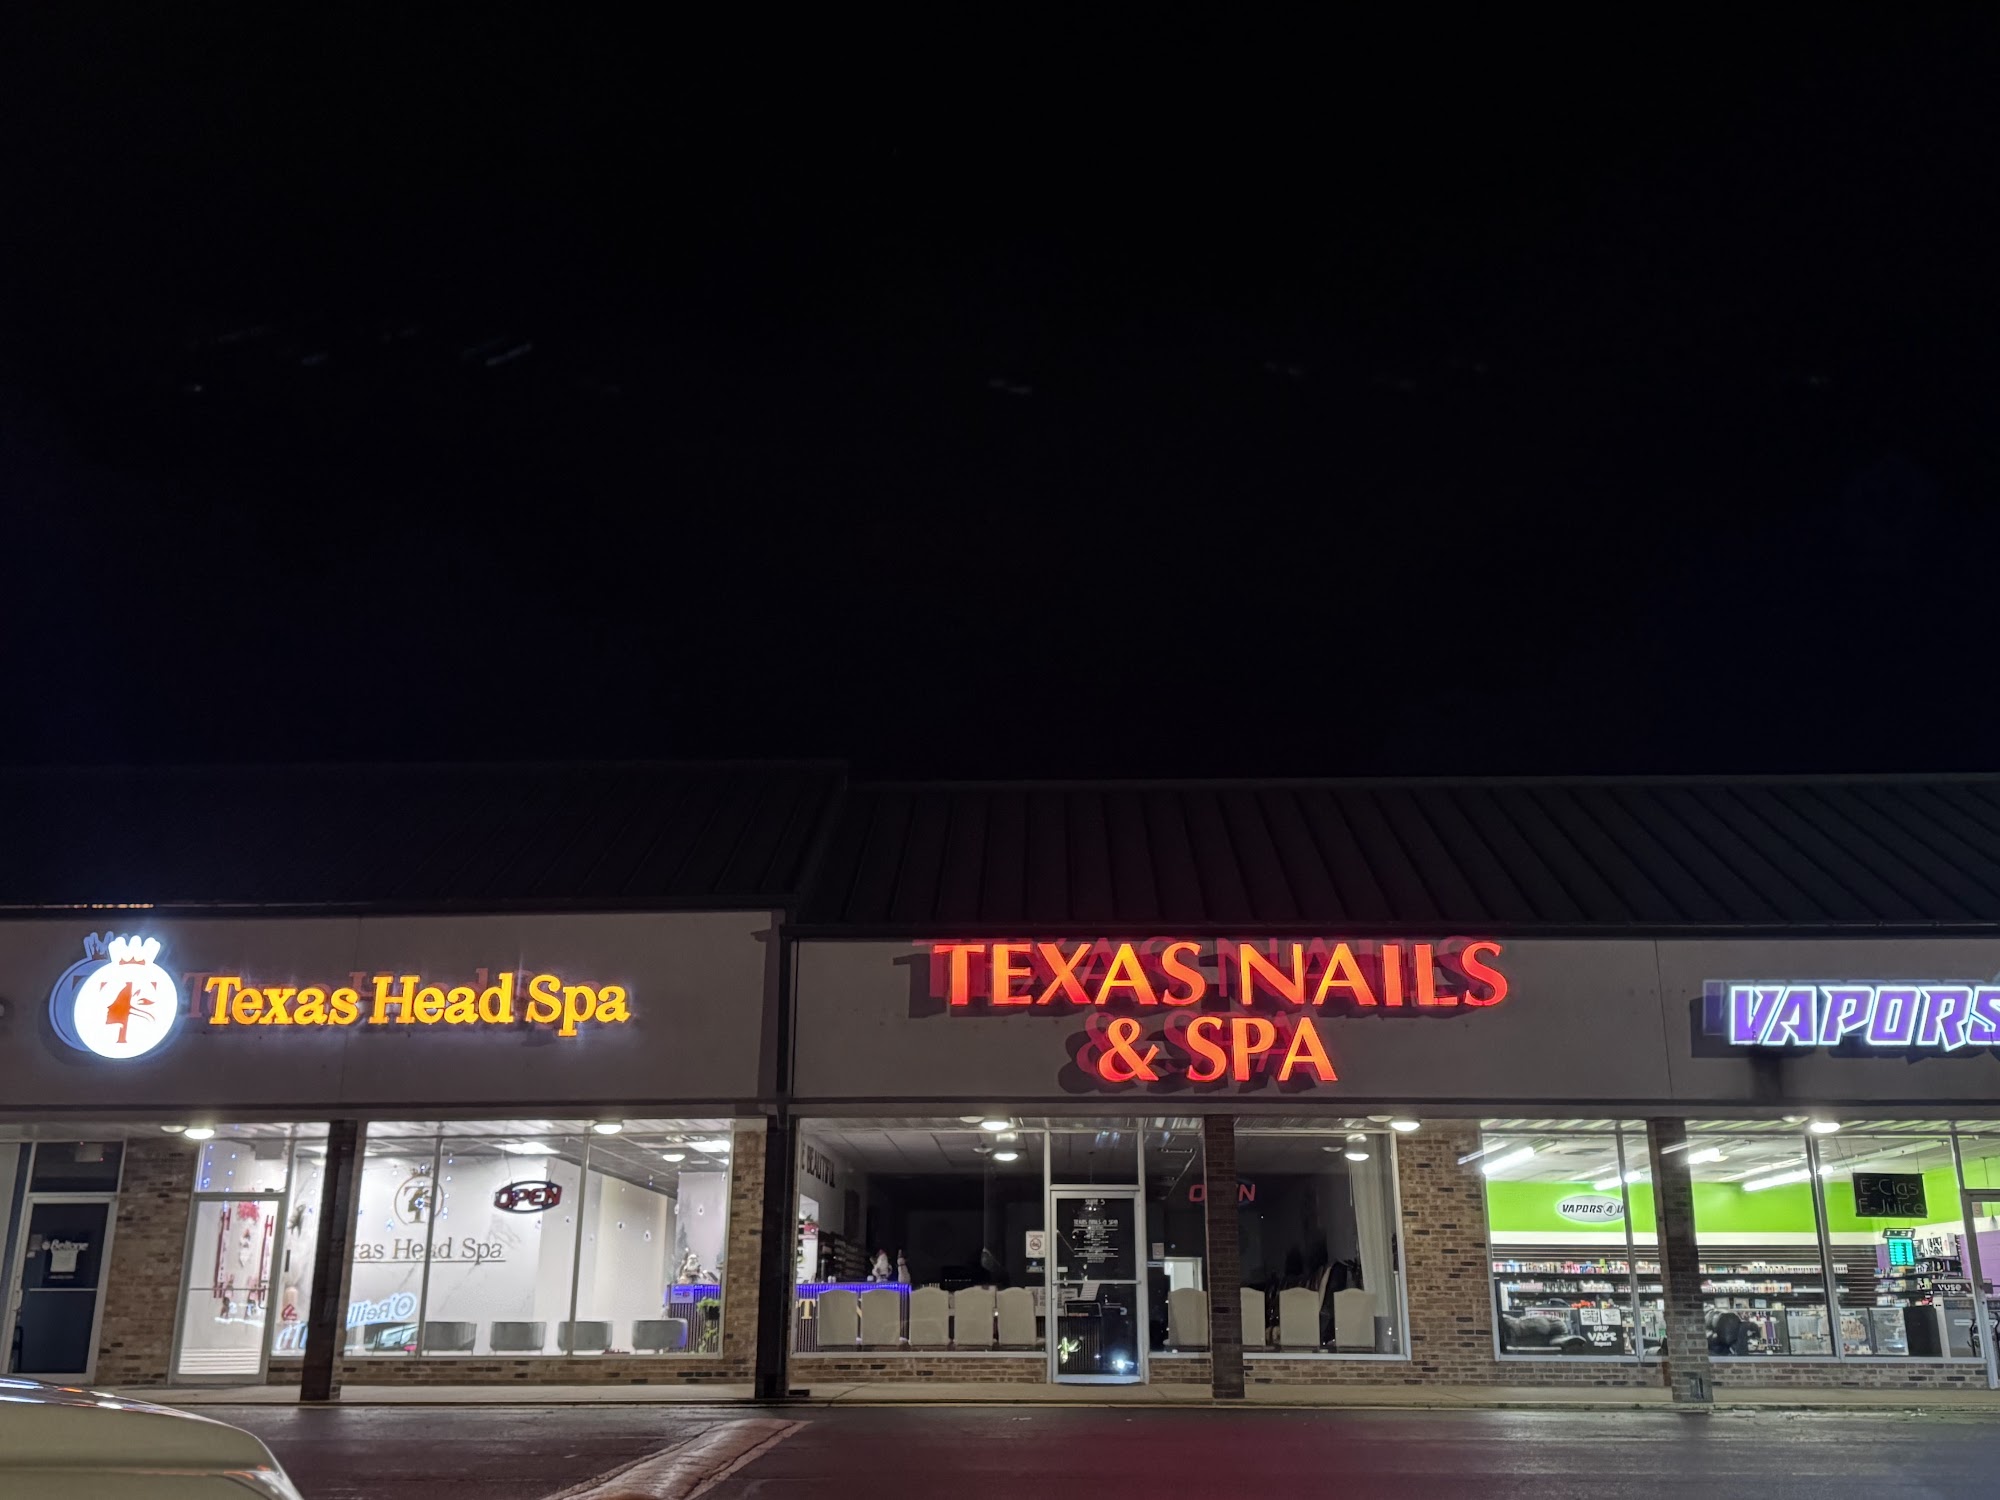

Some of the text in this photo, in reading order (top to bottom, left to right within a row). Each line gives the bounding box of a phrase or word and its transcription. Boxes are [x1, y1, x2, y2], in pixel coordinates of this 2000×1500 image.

[934, 942, 1509, 1006] TEXAS NAILS
[205, 972, 631, 1037] Texas Head Spa
[1729, 986, 2000, 1052] VAPORS
[1098, 1016, 1338, 1082] & SPA
[495, 1186, 563, 1208] OPEN
[1188, 1184, 1256, 1202] ON
[1859, 1178, 1920, 1200] E-Cigs
[1562, 1204, 1603, 1214] VAPORS
[1857, 1197, 1926, 1216] E-Juice
[461, 1238, 502, 1265] Spa
